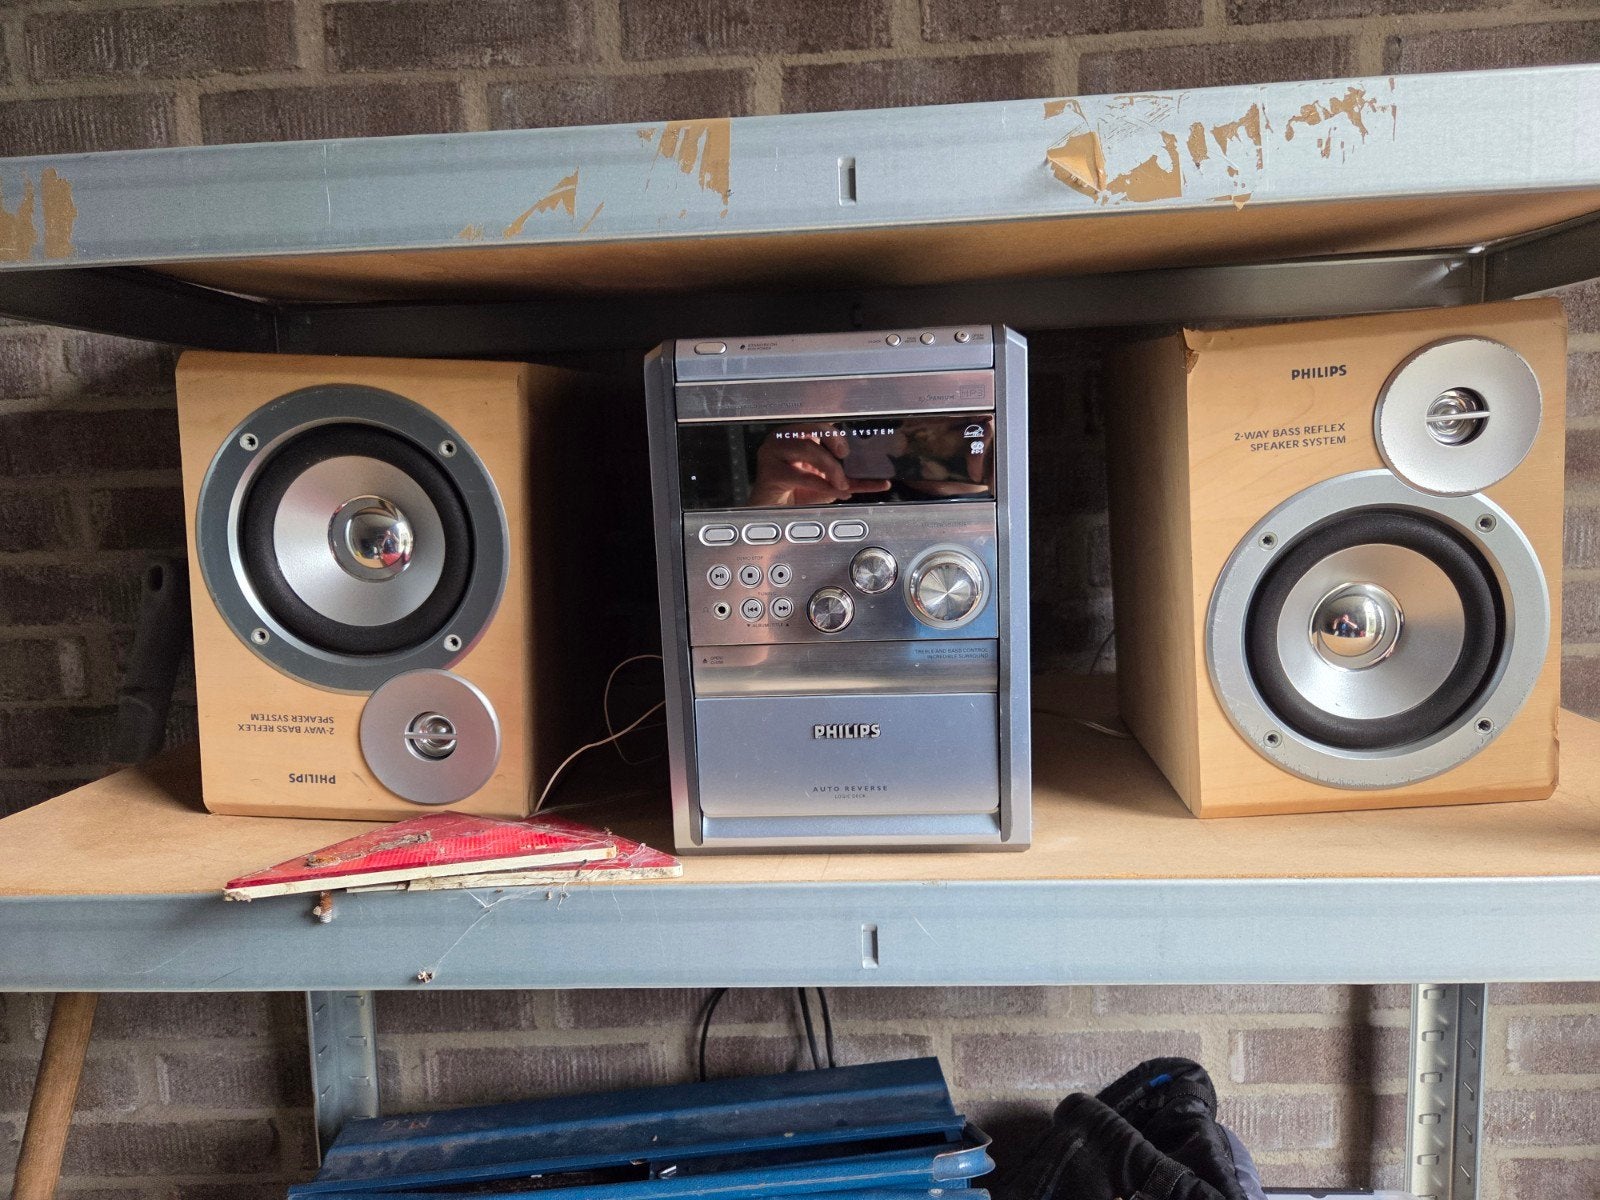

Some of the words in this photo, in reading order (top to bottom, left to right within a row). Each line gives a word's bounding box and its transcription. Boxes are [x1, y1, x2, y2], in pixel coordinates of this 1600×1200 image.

[1291, 365, 1347, 380] PHILIPS
[811, 430, 846, 438] MICRO
[852, 428, 894, 436] SYSTEM
[1234, 430, 1269, 441] 2-WAY
[1272, 426, 1301, 438] BASS
[1303, 422, 1346, 434] REFLEX
[1250, 440, 1299, 452] SPEAKER
[1302, 435, 1346, 447] SYSTEM
[250, 713, 289, 722] SYSTEM
[291, 714, 334, 723] SPEAKER
[237, 723, 274, 732] REFLEX
[276, 725, 301, 733] BASS
[303, 726, 335, 735] 2-WAY
[813, 724, 881, 739] PHILIPS
[289, 773, 336, 784] PHILIPS
